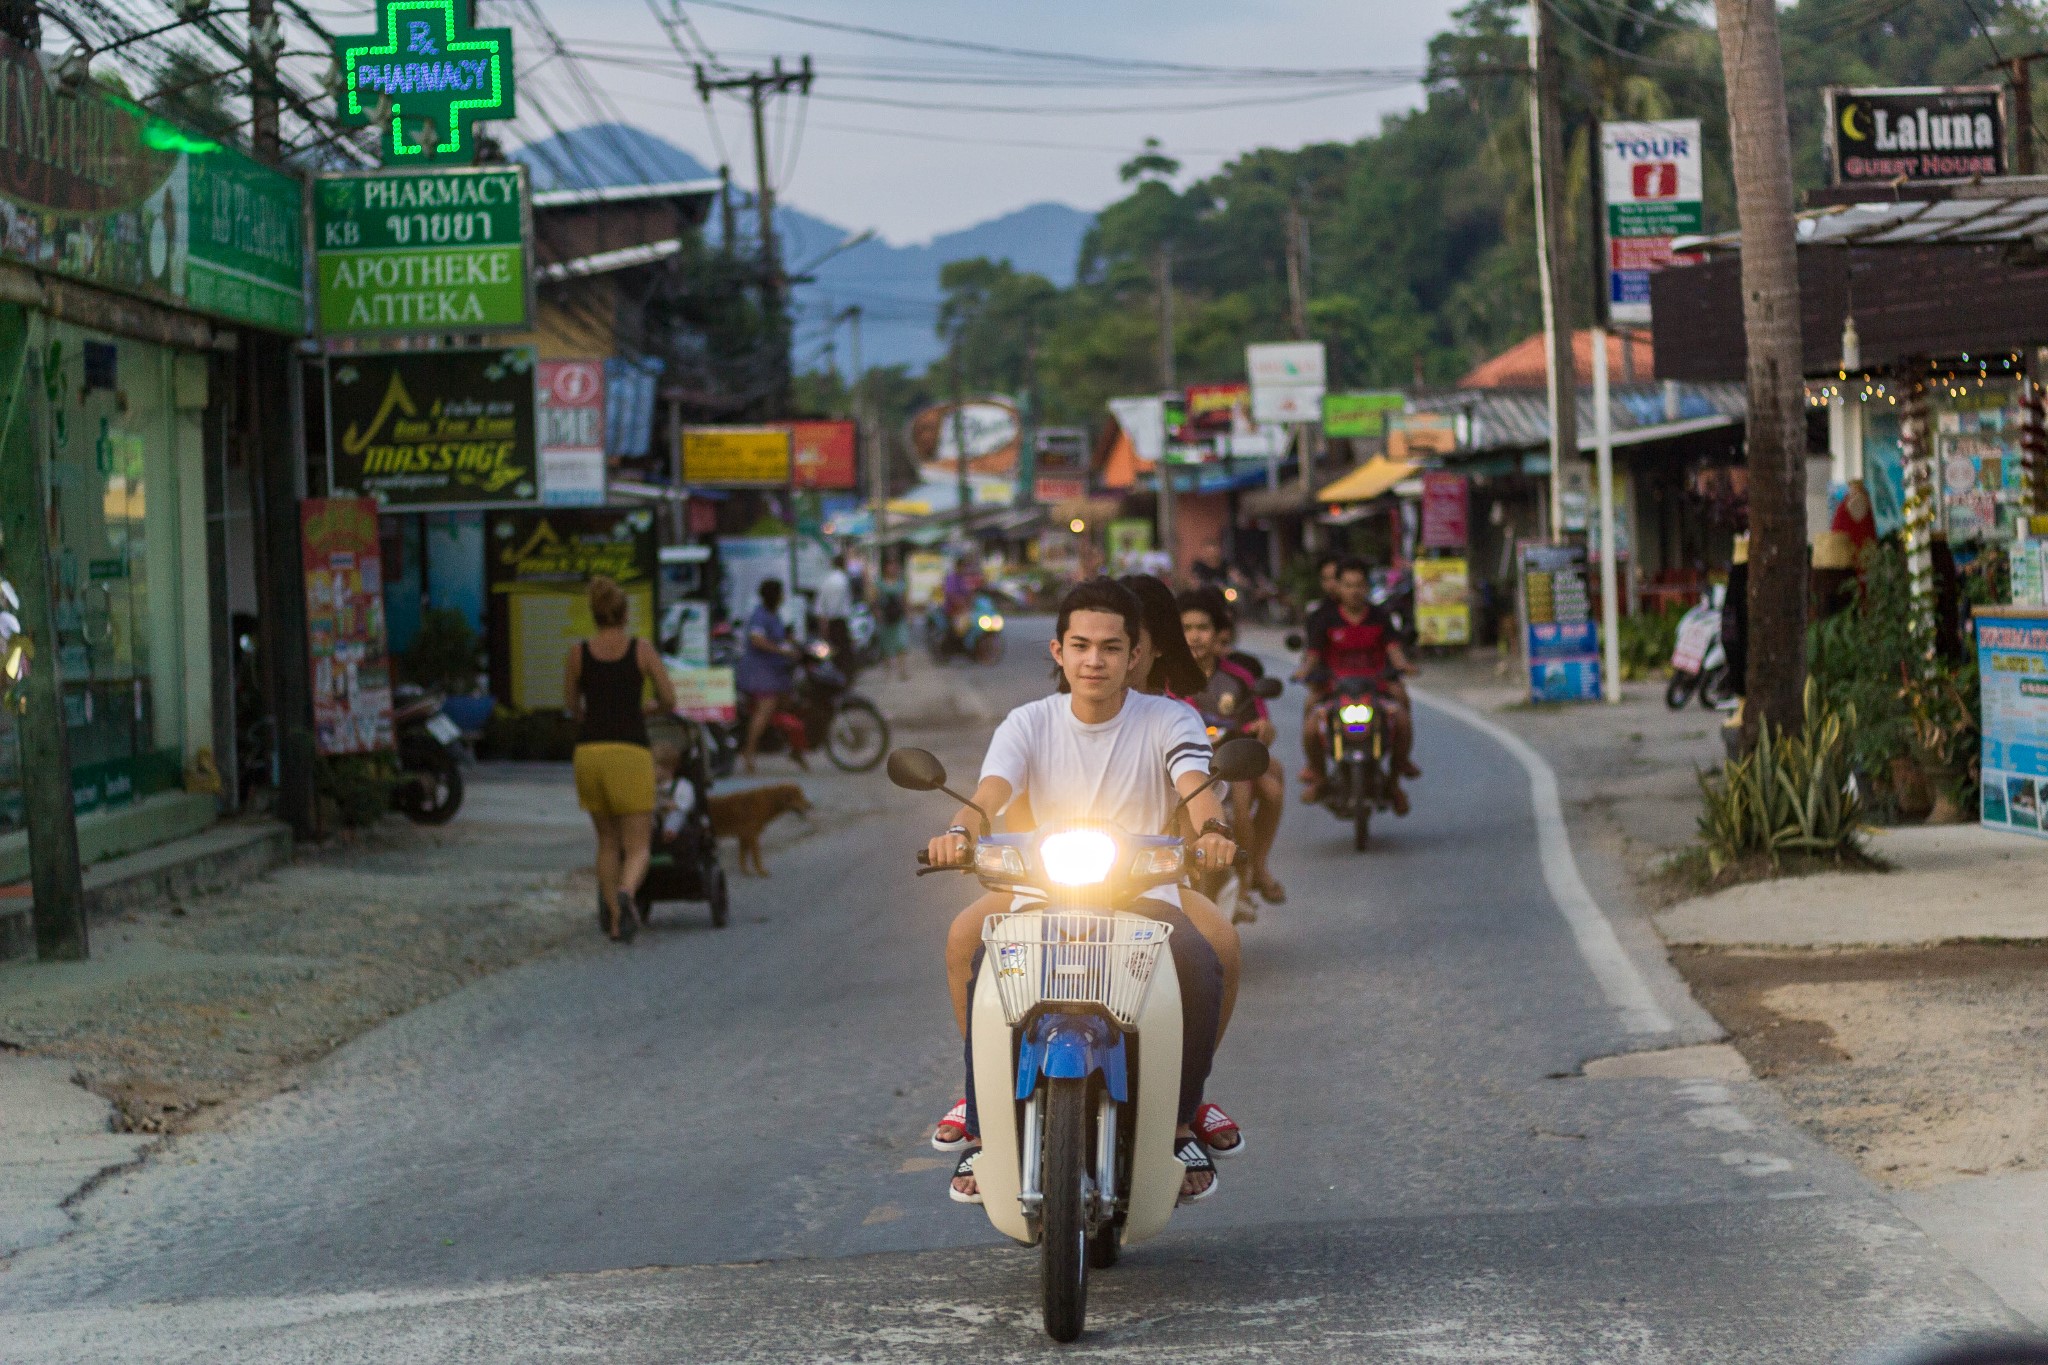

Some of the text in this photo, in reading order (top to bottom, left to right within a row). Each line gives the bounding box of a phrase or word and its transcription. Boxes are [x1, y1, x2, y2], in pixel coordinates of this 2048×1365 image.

[358, 59, 488, 94] PHARMACY
[1873, 107, 1994, 150] Laluna
[1616, 137, 1690, 159] TOUR
[1921, 154, 1996, 175] HOUSE
[364, 175, 516, 208] PHARMACY
[325, 221, 361, 246] KB
[386, 211, 493, 244] ขายยา
[333, 253, 513, 289] APOTHEKE
[350, 291, 486, 325] АПТЕКА
